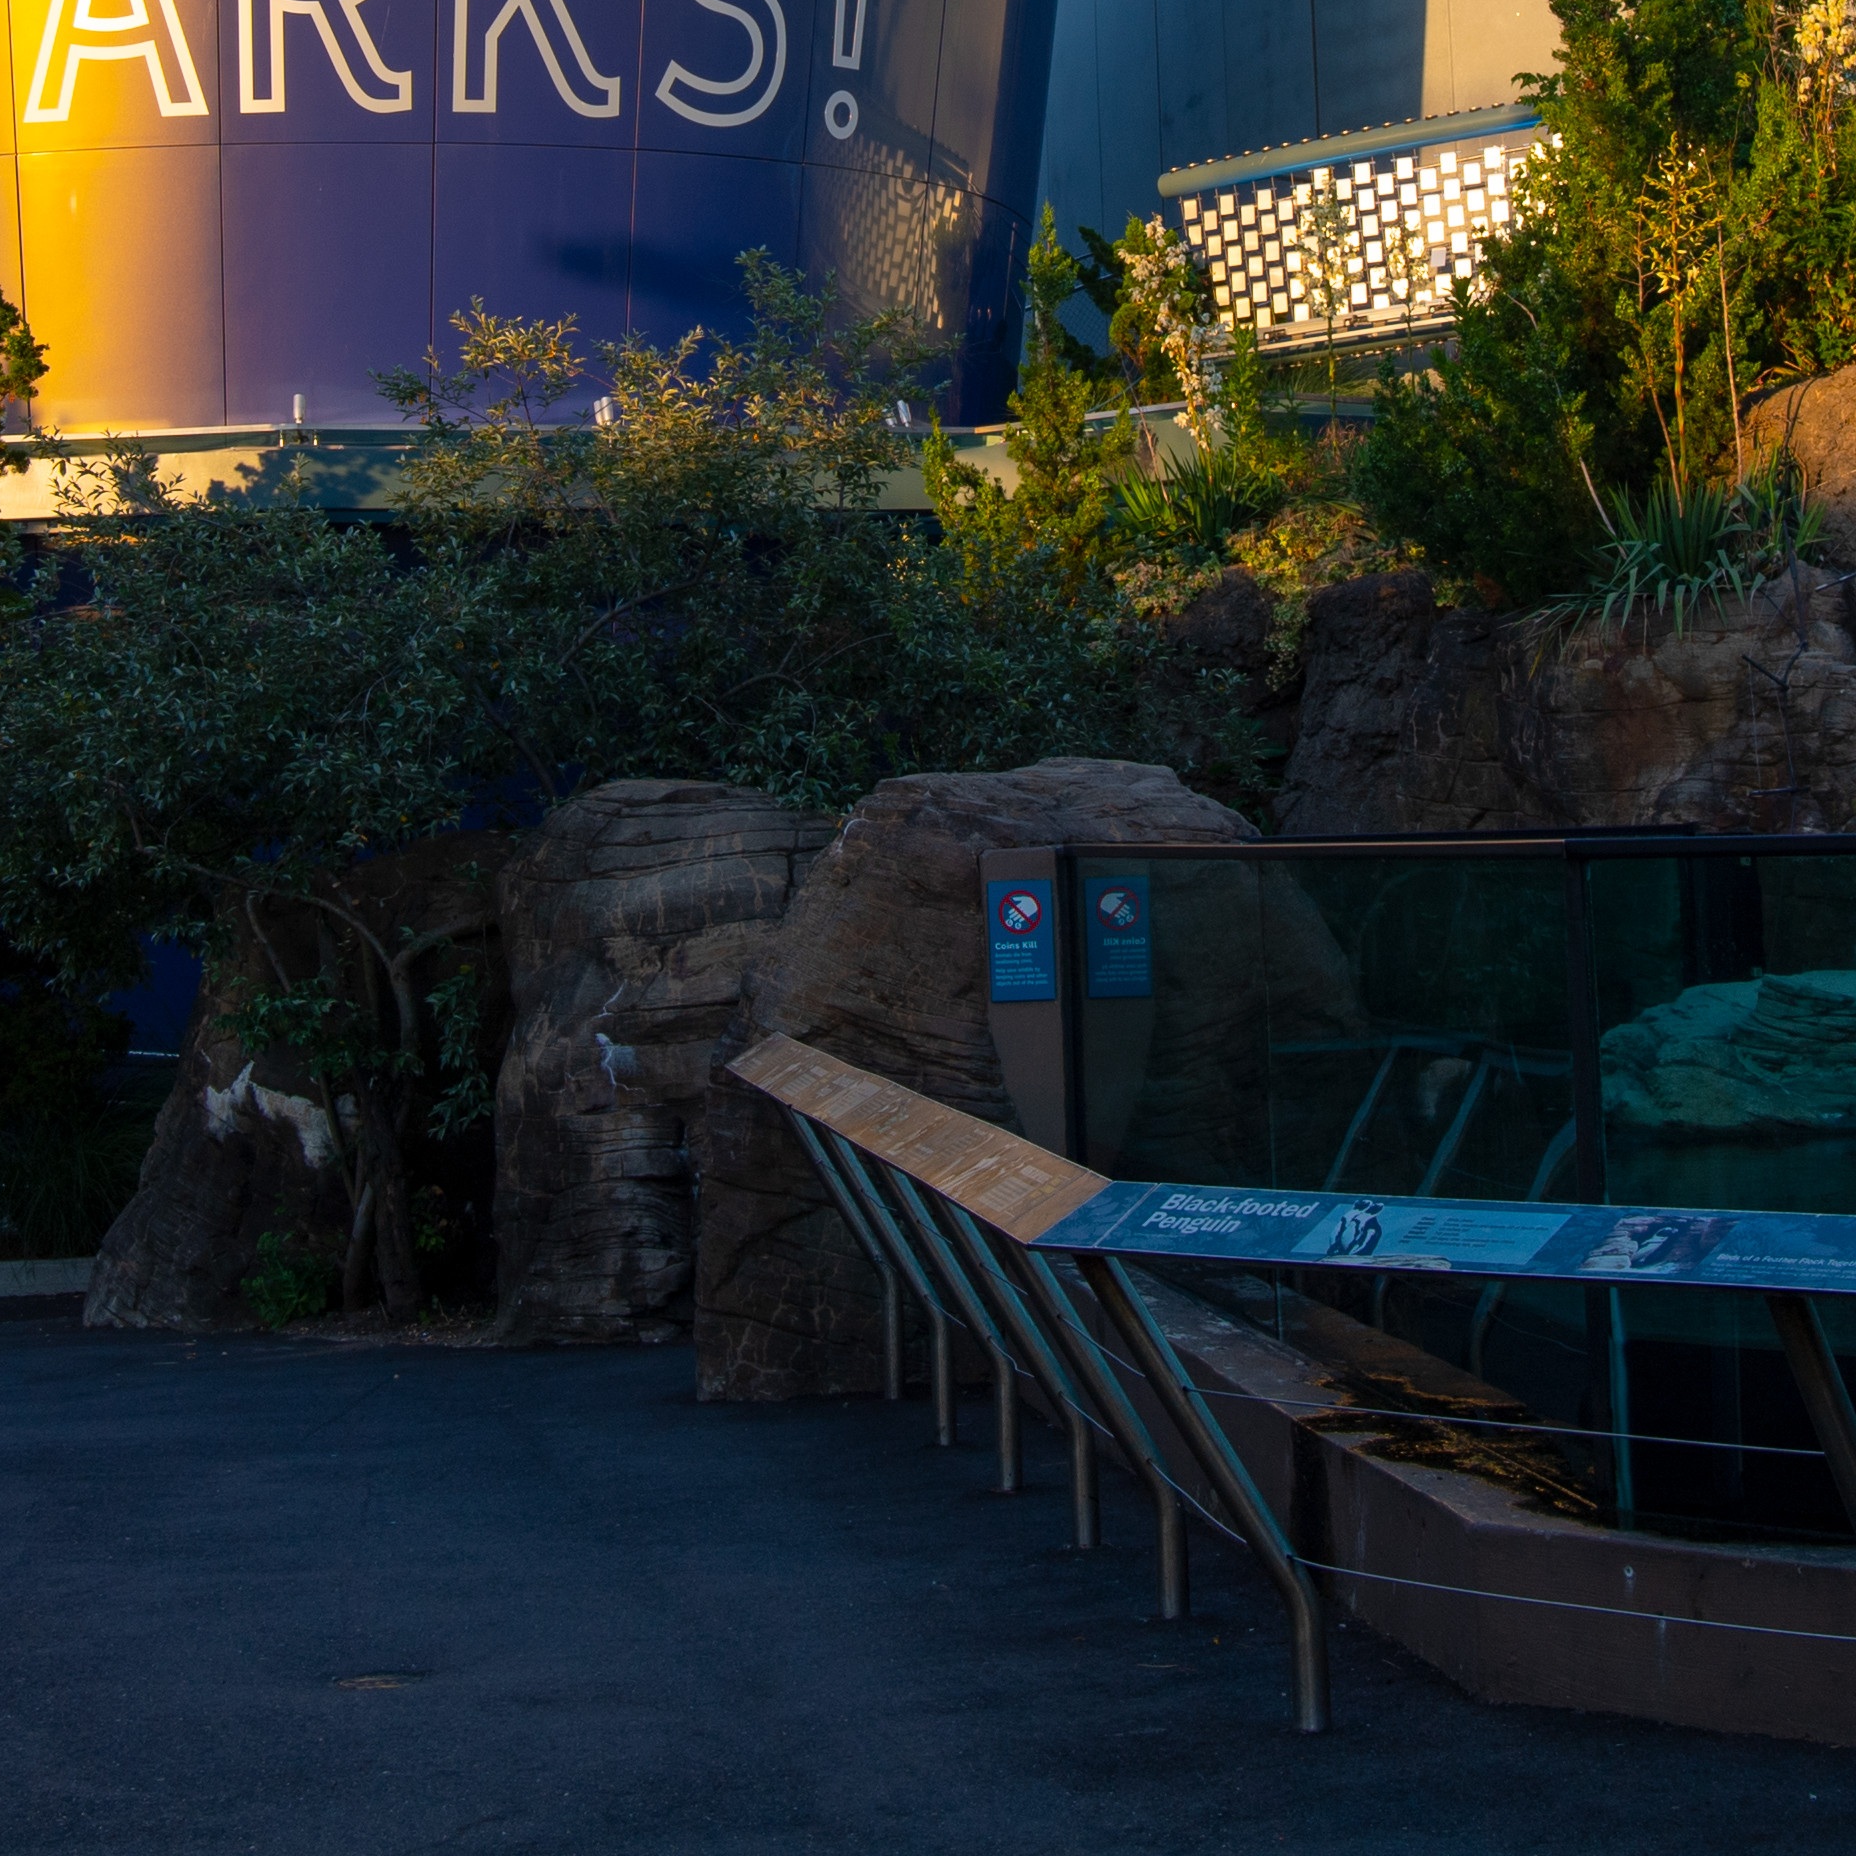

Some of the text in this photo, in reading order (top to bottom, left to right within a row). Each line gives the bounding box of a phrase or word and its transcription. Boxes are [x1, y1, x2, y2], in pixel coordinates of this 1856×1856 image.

[995, 940, 1038, 950] Coins Kill
[1160, 1193, 1321, 1219] Black-footed
[1142, 1211, 1242, 1235] Penguin
[1716, 1253, 1740, 1262] Birds
[1742, 1254, 1754, 1262] of
[1762, 1255, 1797, 1264] Feather
[1799, 1257, 1825, 1266] Flock
